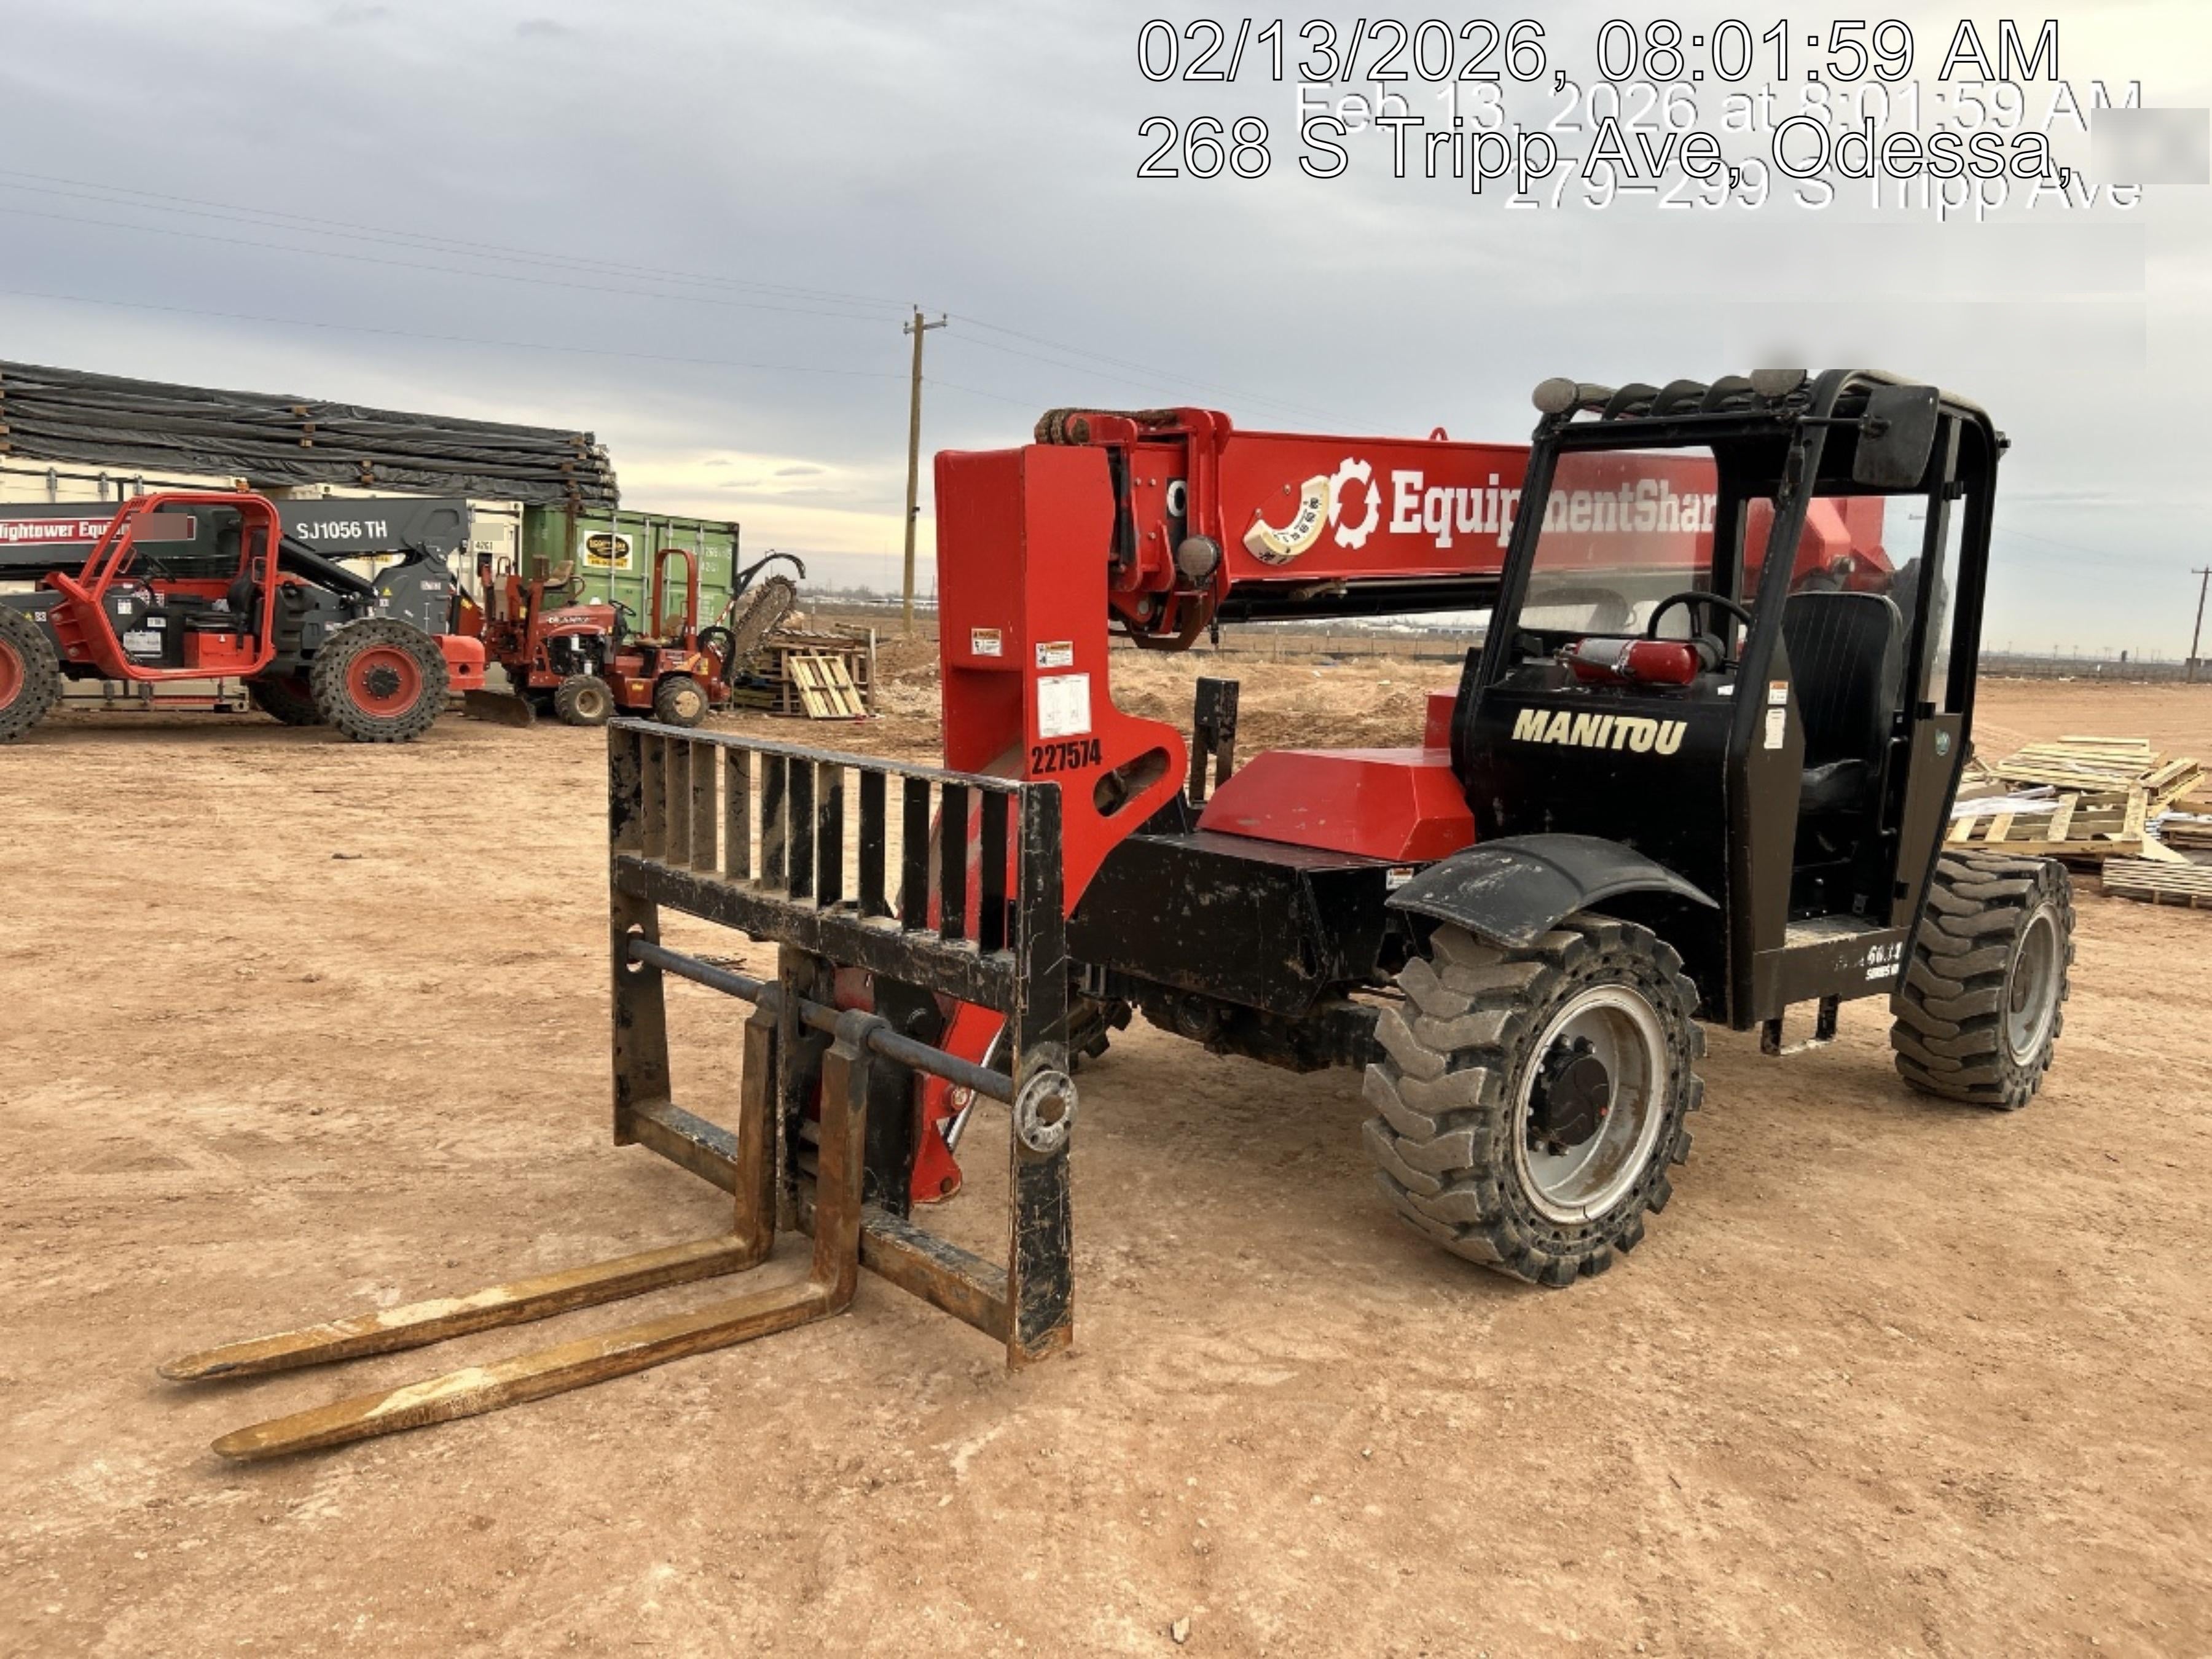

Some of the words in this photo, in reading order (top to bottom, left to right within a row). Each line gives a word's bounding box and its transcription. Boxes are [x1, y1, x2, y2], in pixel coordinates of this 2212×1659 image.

[296, 521, 362, 539] SJ1056
[365, 520, 388, 538] TH
[1512, 709, 1688, 755] MANITOU
[1032, 739, 1102, 775] 227574
